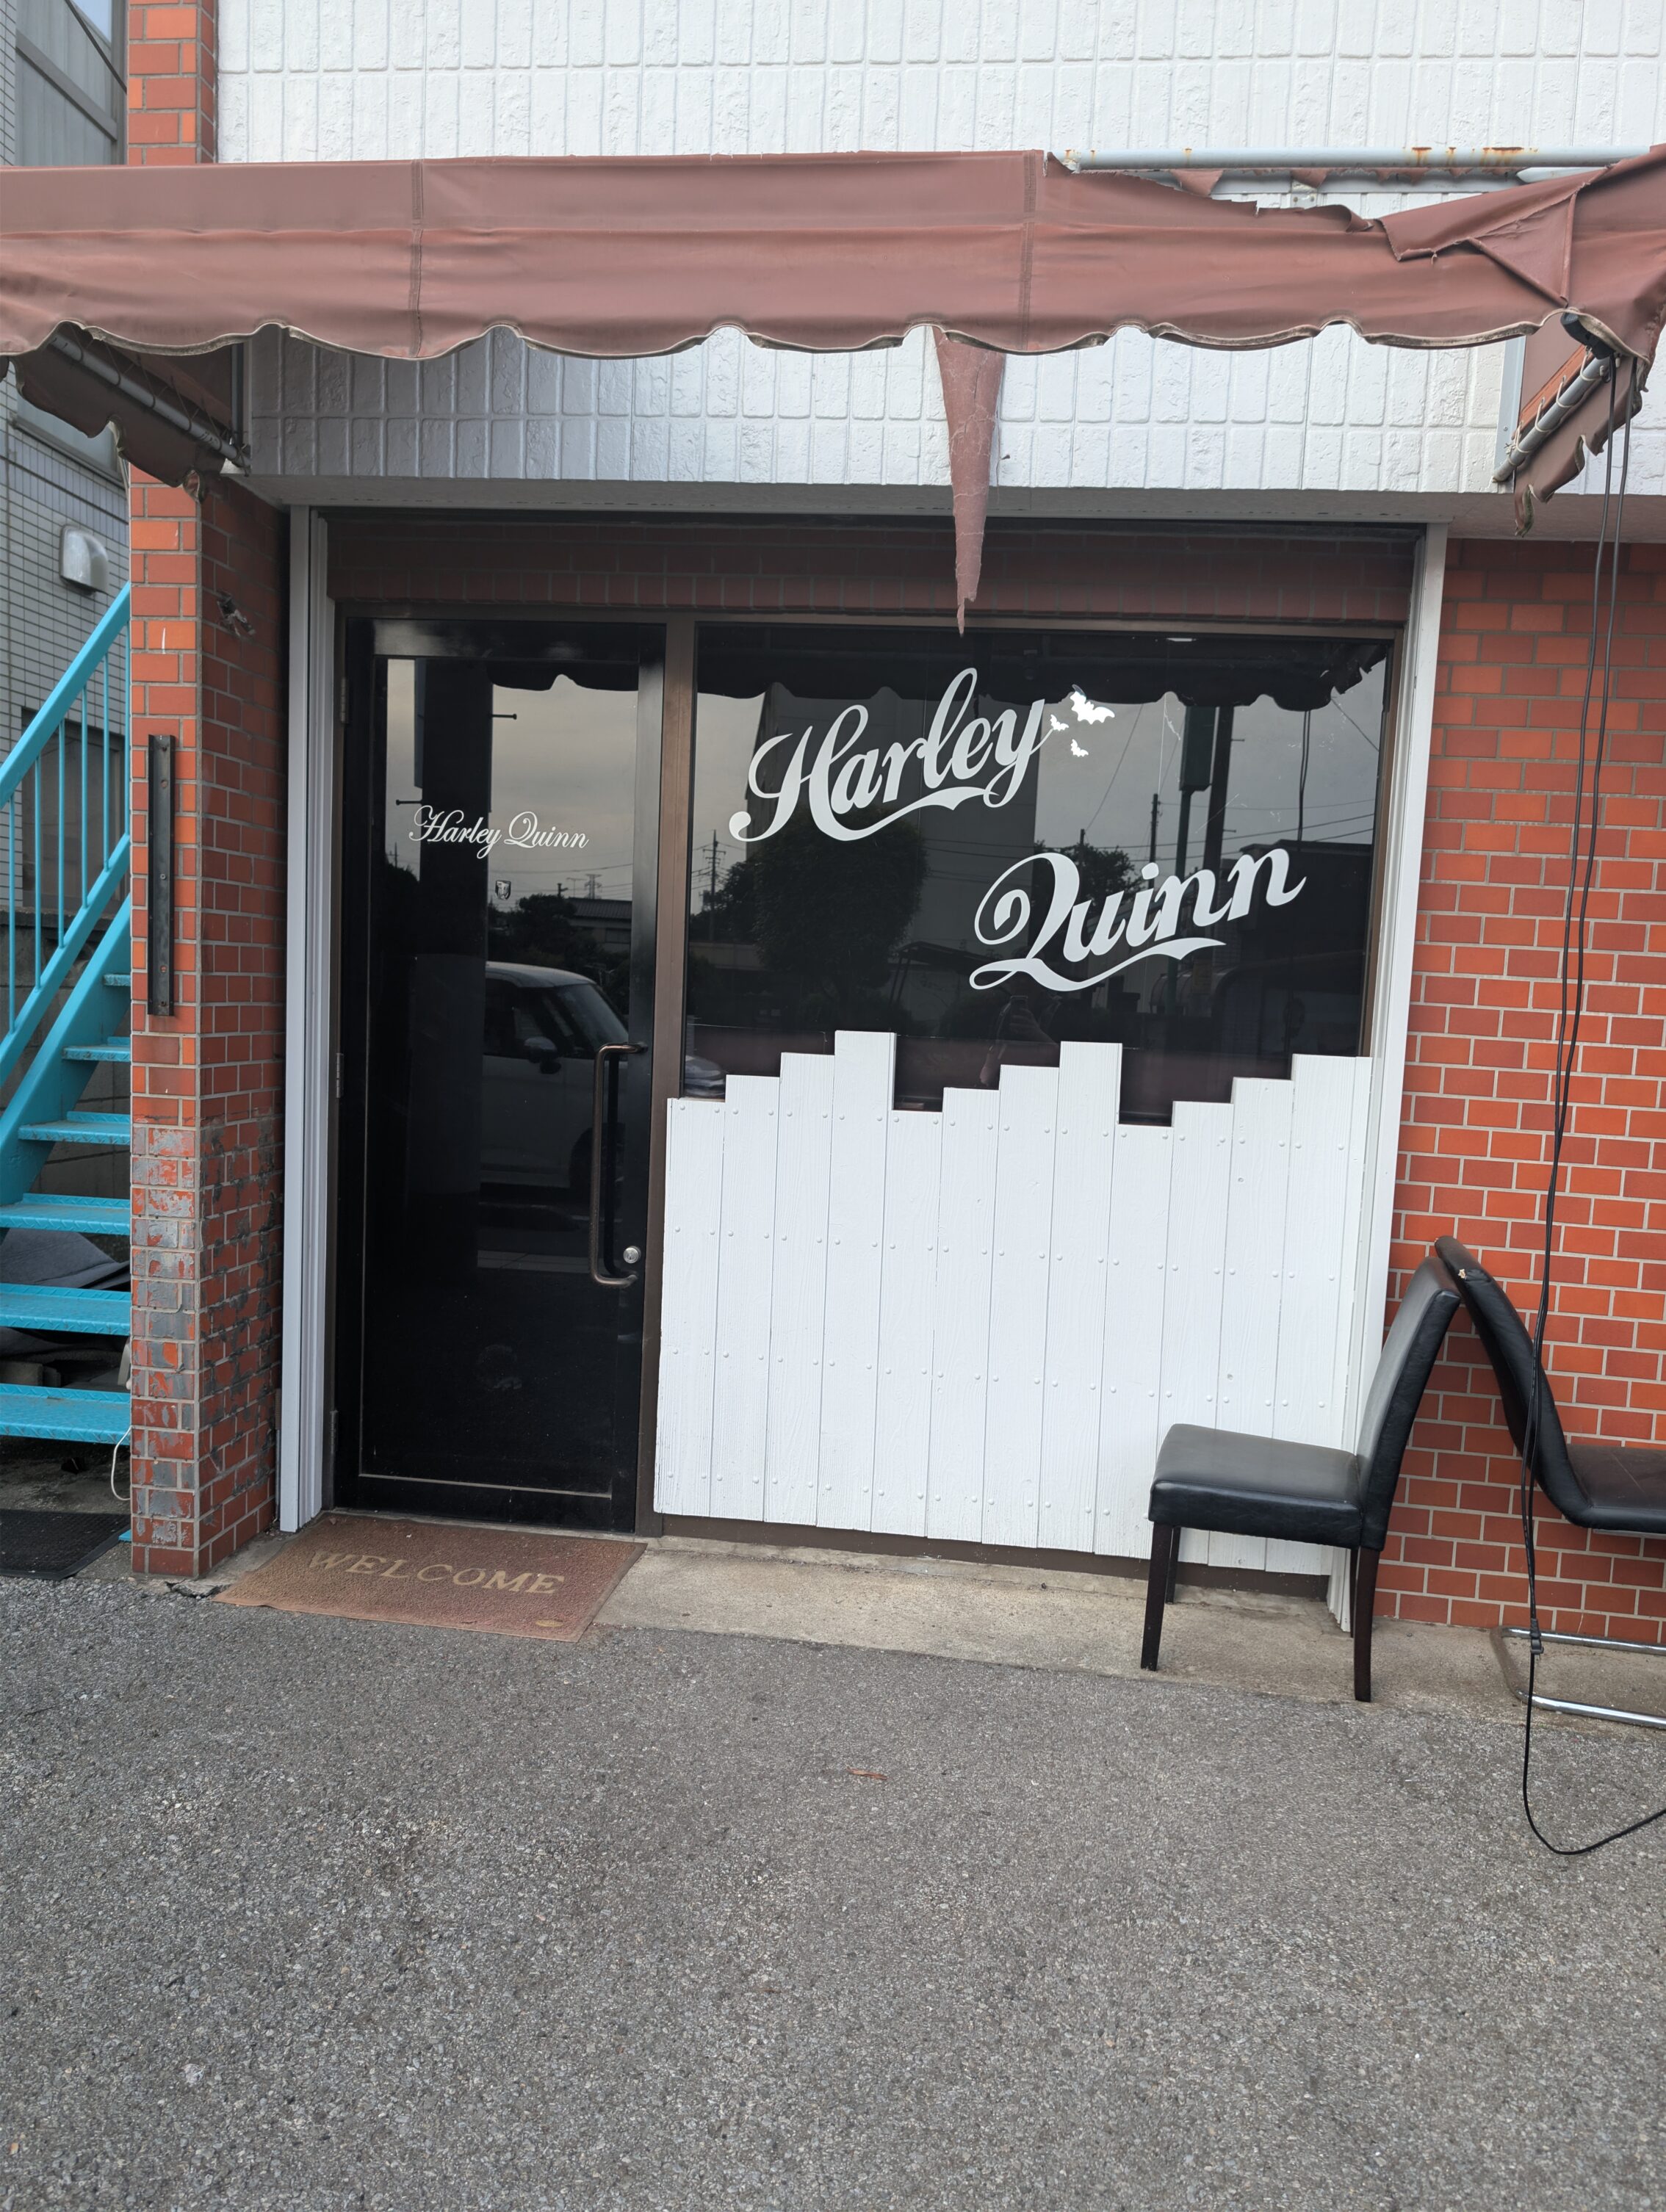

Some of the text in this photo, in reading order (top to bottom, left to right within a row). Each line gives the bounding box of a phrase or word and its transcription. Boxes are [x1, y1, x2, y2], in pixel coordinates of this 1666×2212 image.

[729, 668, 1050, 842] Harley
[408, 805, 589, 859] Harley Quinn
[969, 847, 1307, 992] Quinn
[307, 1551, 565, 1594] WELCOME
